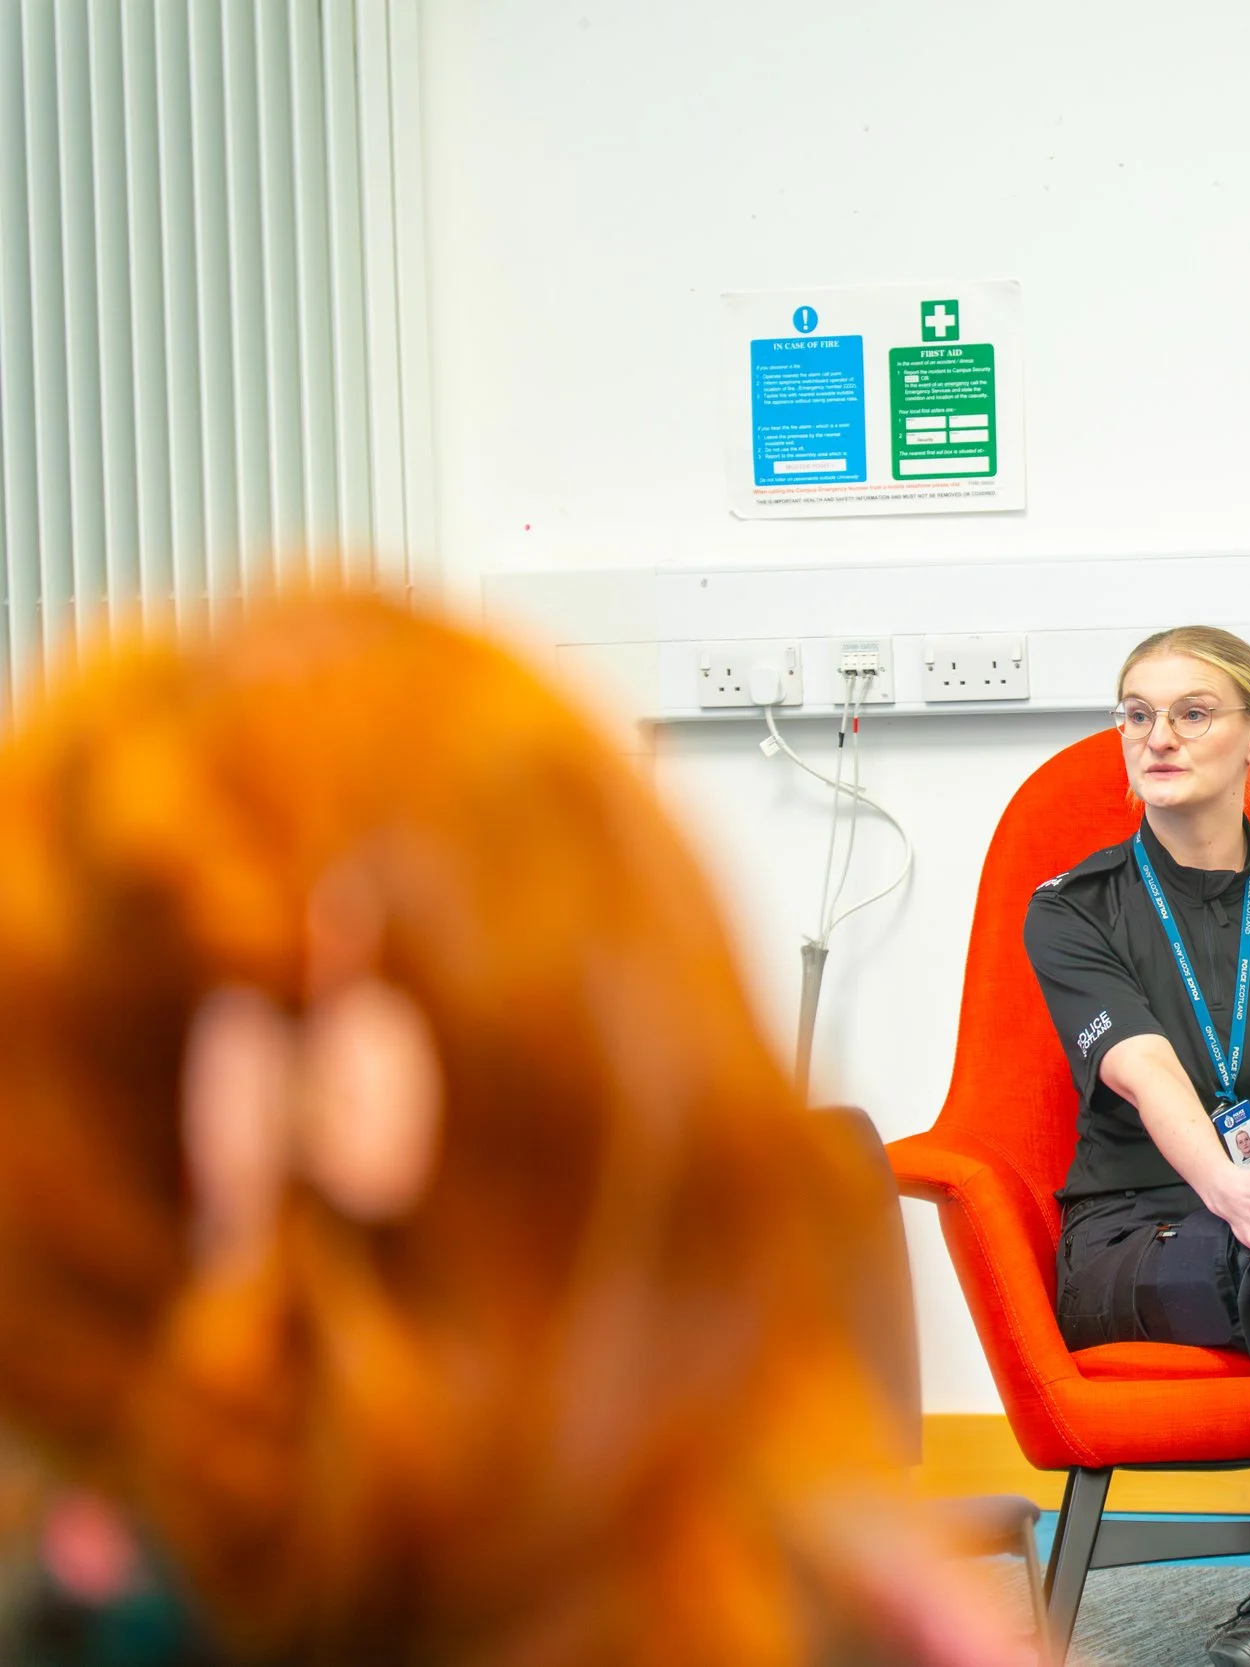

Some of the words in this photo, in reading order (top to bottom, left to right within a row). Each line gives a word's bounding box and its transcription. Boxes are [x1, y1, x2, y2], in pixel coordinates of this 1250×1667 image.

[785, 342, 806, 350] CASE
[1143, 864, 1160, 897] SCOTLAND
[1155, 896, 1169, 920] POLICE
[1173, 942, 1191, 977] SCOTLAND
[1240, 958, 1249, 983] POLICE
[1187, 977, 1200, 1001] POLICE
[1236, 983, 1246, 1021] SCOTLAND
[1077, 1010, 1110, 1050] POLICE
[1205, 1025, 1223, 1062] SCOTLAND
[1231, 1046, 1240, 1071] POLICE
[1217, 1061, 1230, 1087] POLICE
